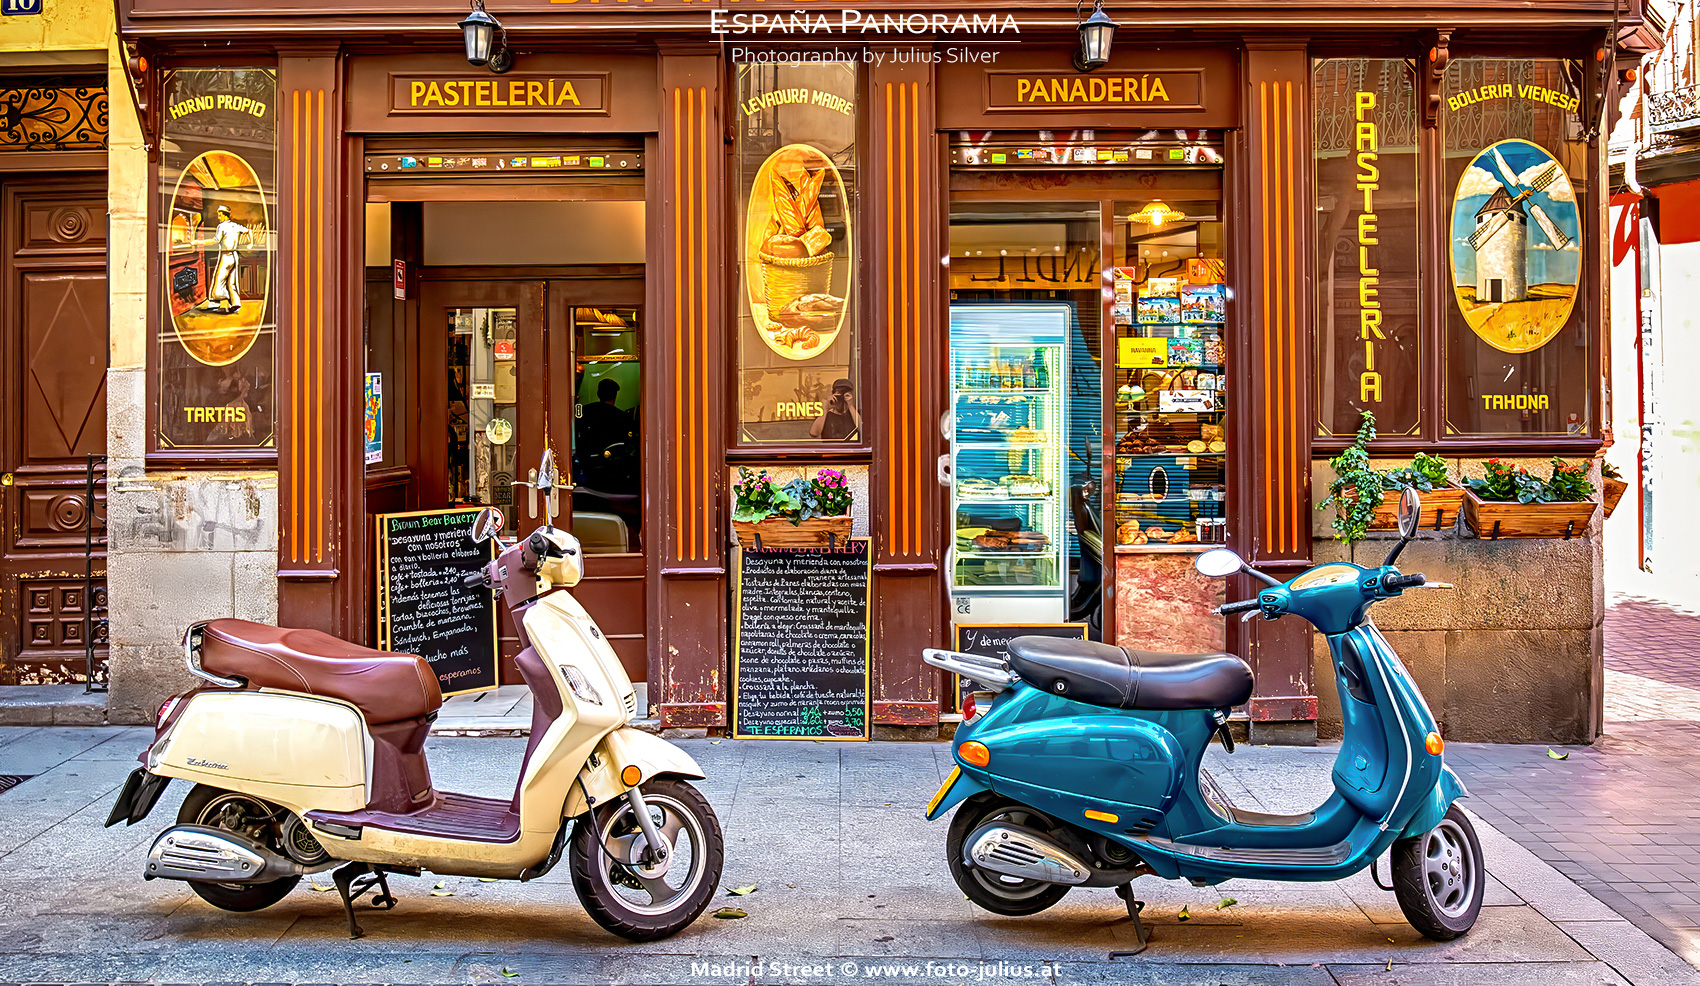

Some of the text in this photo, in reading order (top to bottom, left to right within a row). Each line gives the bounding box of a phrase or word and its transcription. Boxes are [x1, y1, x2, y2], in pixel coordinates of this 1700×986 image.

[410, 78, 581, 107] PASTELERÍA
[1017, 74, 1170, 103] PANADERÍA
[740, 88, 854, 117] LEVADURA MADRE
[1448, 84, 1580, 113] BOLLERIA VIENESA
[169, 94, 266, 120] HORNO PROPIO
[1355, 91, 1385, 403] PASTELERIA
[1482, 394, 1549, 410] TAHONA
[183, 407, 246, 424] TARTAS
[777, 402, 824, 417] PANES
[422, 516, 442, 527] Bear
[444, 513, 476, 525] Bakery
[408, 543, 422, 552] con
[746, 557, 784, 569] Desayuna
[786, 559, 792, 569] y
[744, 578, 772, 586] Tostadas
[450, 586, 460, 595] las
[859, 598, 866, 606] de
[743, 612, 762, 620] Bagel
[393, 619, 424, 633] Crumble
[426, 619, 436, 628] de
[826, 621, 833, 630] de
[813, 640, 820, 648] de
[425, 645, 469, 663] ucho más
[788, 648, 796, 656] de
[770, 656, 801, 664] chocolate
[857, 657, 865, 666] de
[439, 667, 481, 685] esperamos
